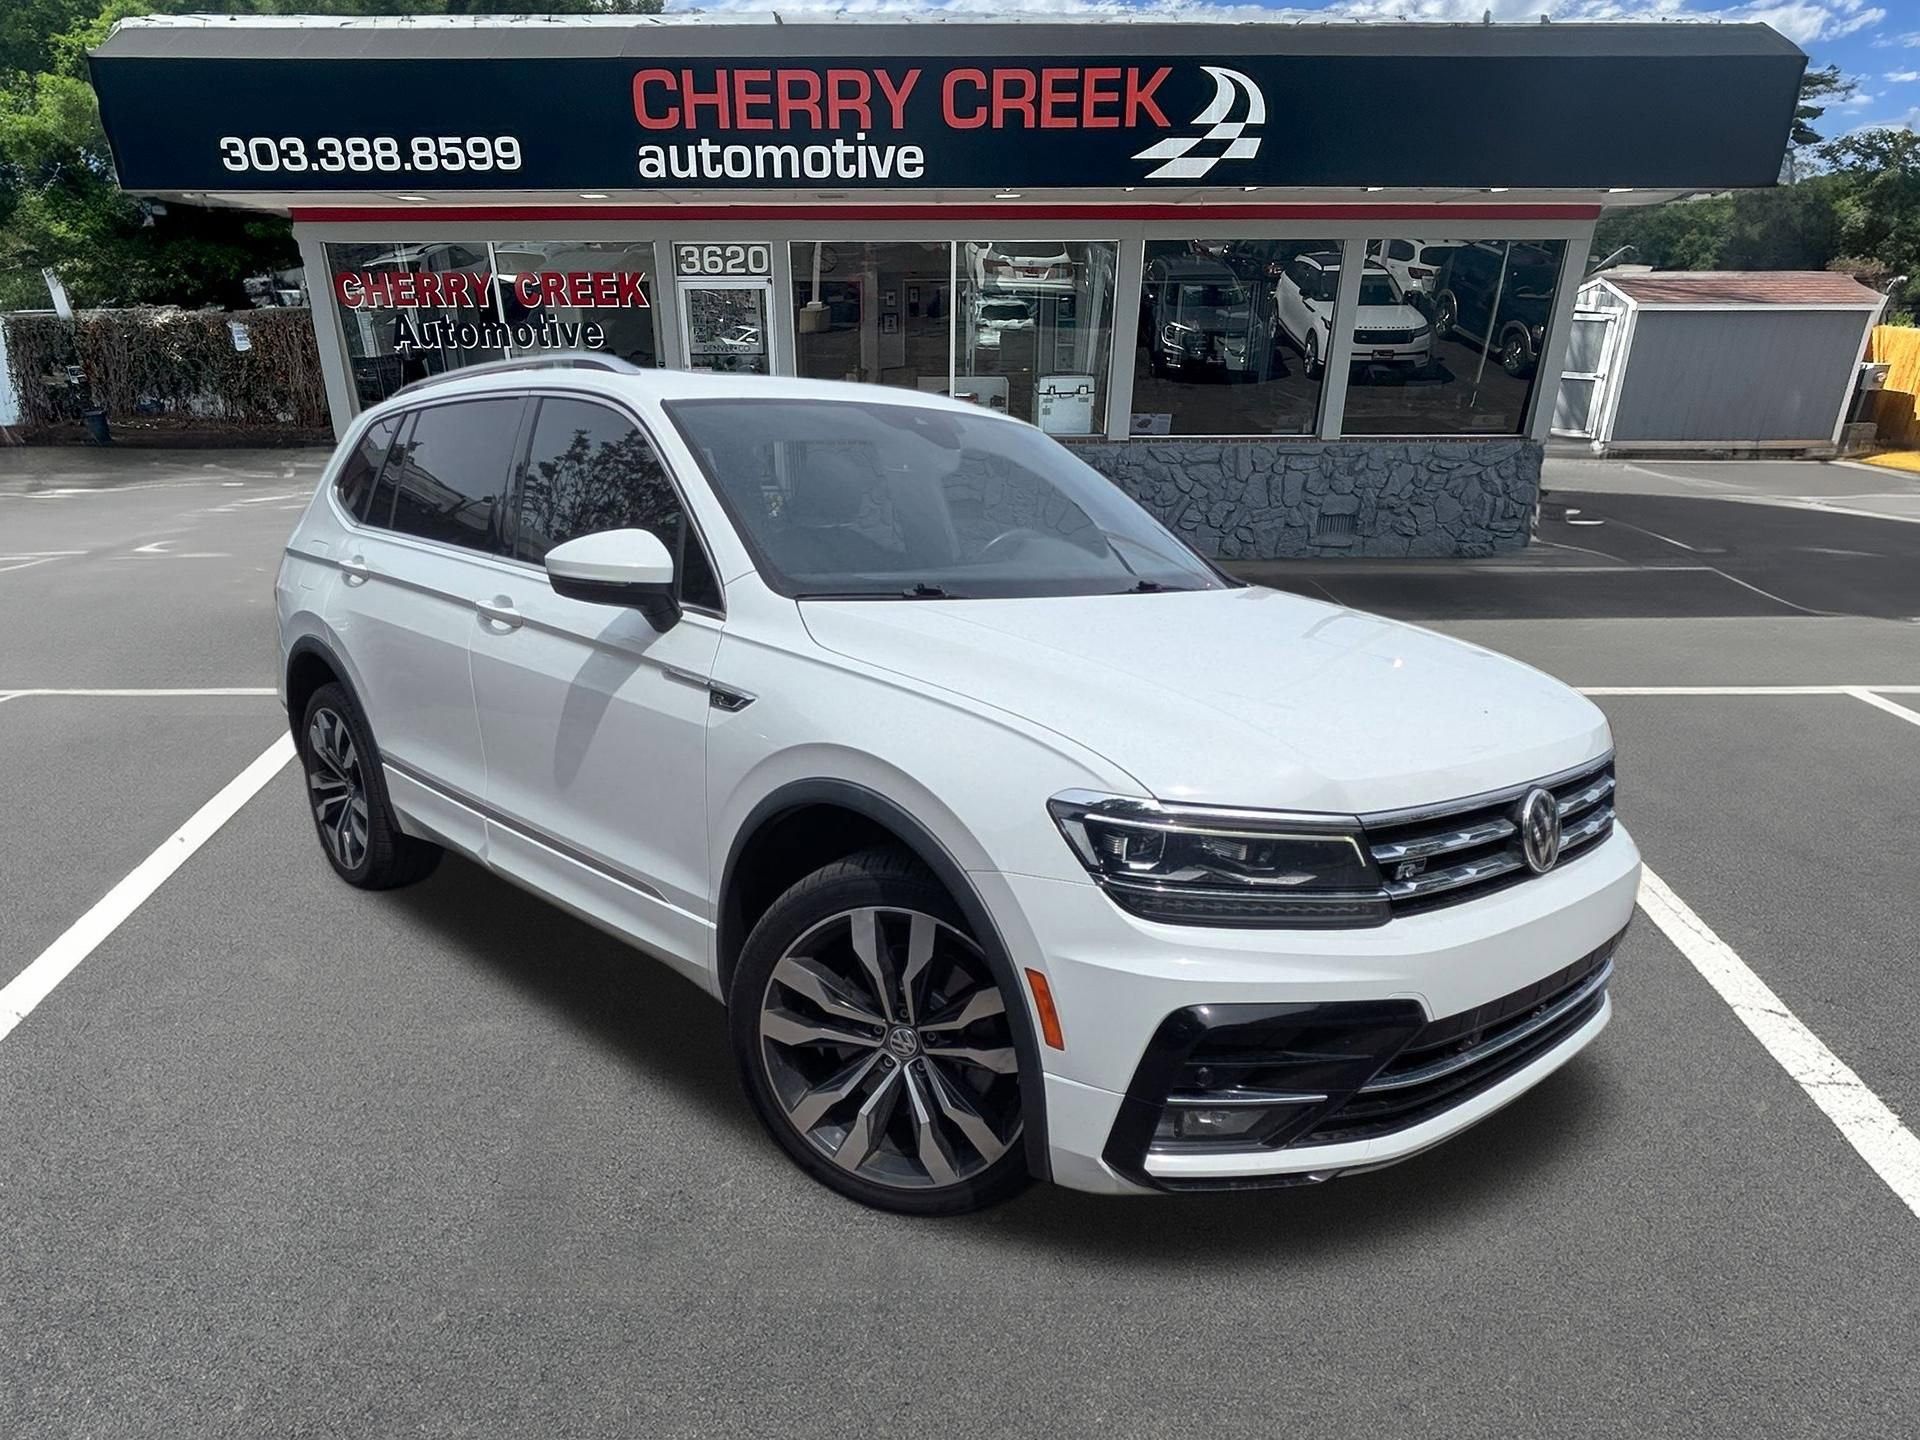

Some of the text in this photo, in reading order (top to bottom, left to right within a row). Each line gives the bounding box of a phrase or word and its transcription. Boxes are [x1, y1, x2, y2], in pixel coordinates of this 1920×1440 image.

[632, 67, 1173, 130] CHERRY CREEK
[219, 135, 523, 172] 303.388.8599
[638, 132, 925, 179] automotive
[680, 245, 769, 274] 3620
[335, 271, 650, 309] CHERRY CREEK
[393, 314, 606, 350] Automotive
